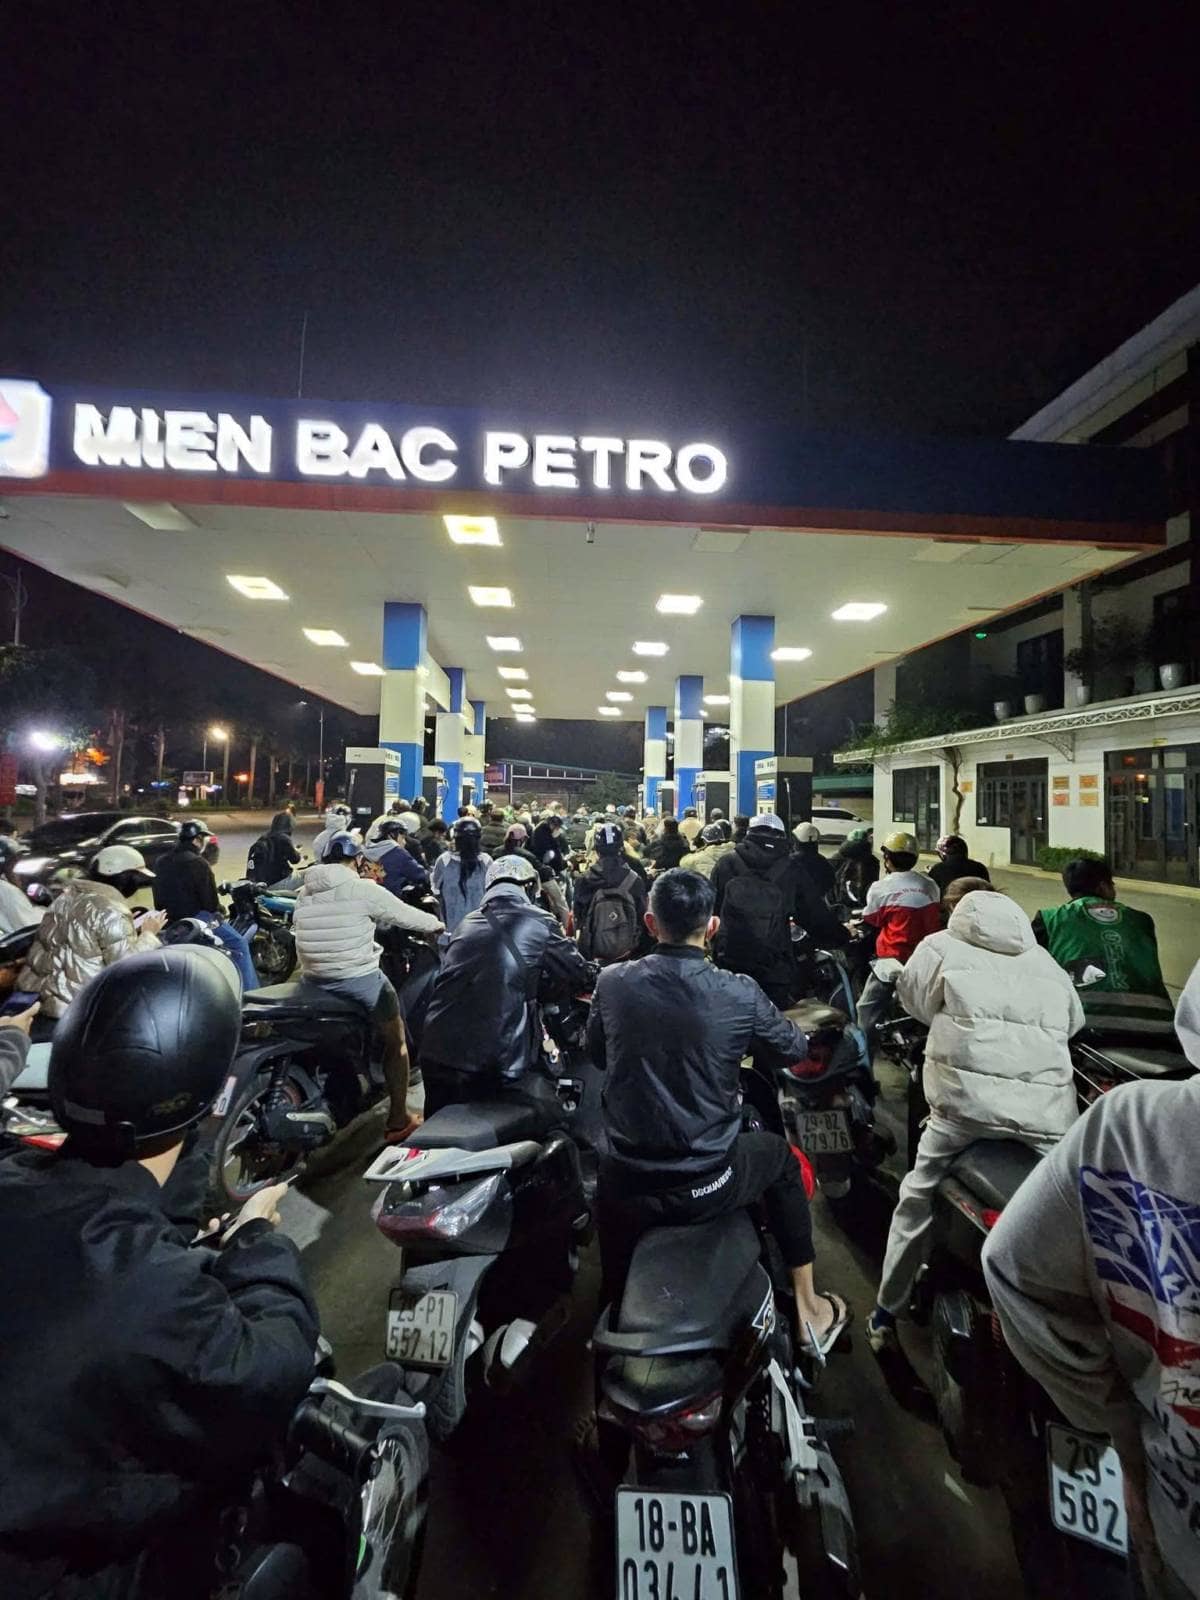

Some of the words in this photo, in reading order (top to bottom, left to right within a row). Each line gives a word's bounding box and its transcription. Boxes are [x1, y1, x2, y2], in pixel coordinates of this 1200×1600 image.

[73, 403, 272, 473] MIEN
[297, 419, 457, 482] BAC
[484, 432, 727, 494] PETRO
[389, 1326, 448, 1361] 557.12
[634, 1498, 716, 1557] 18-BA
